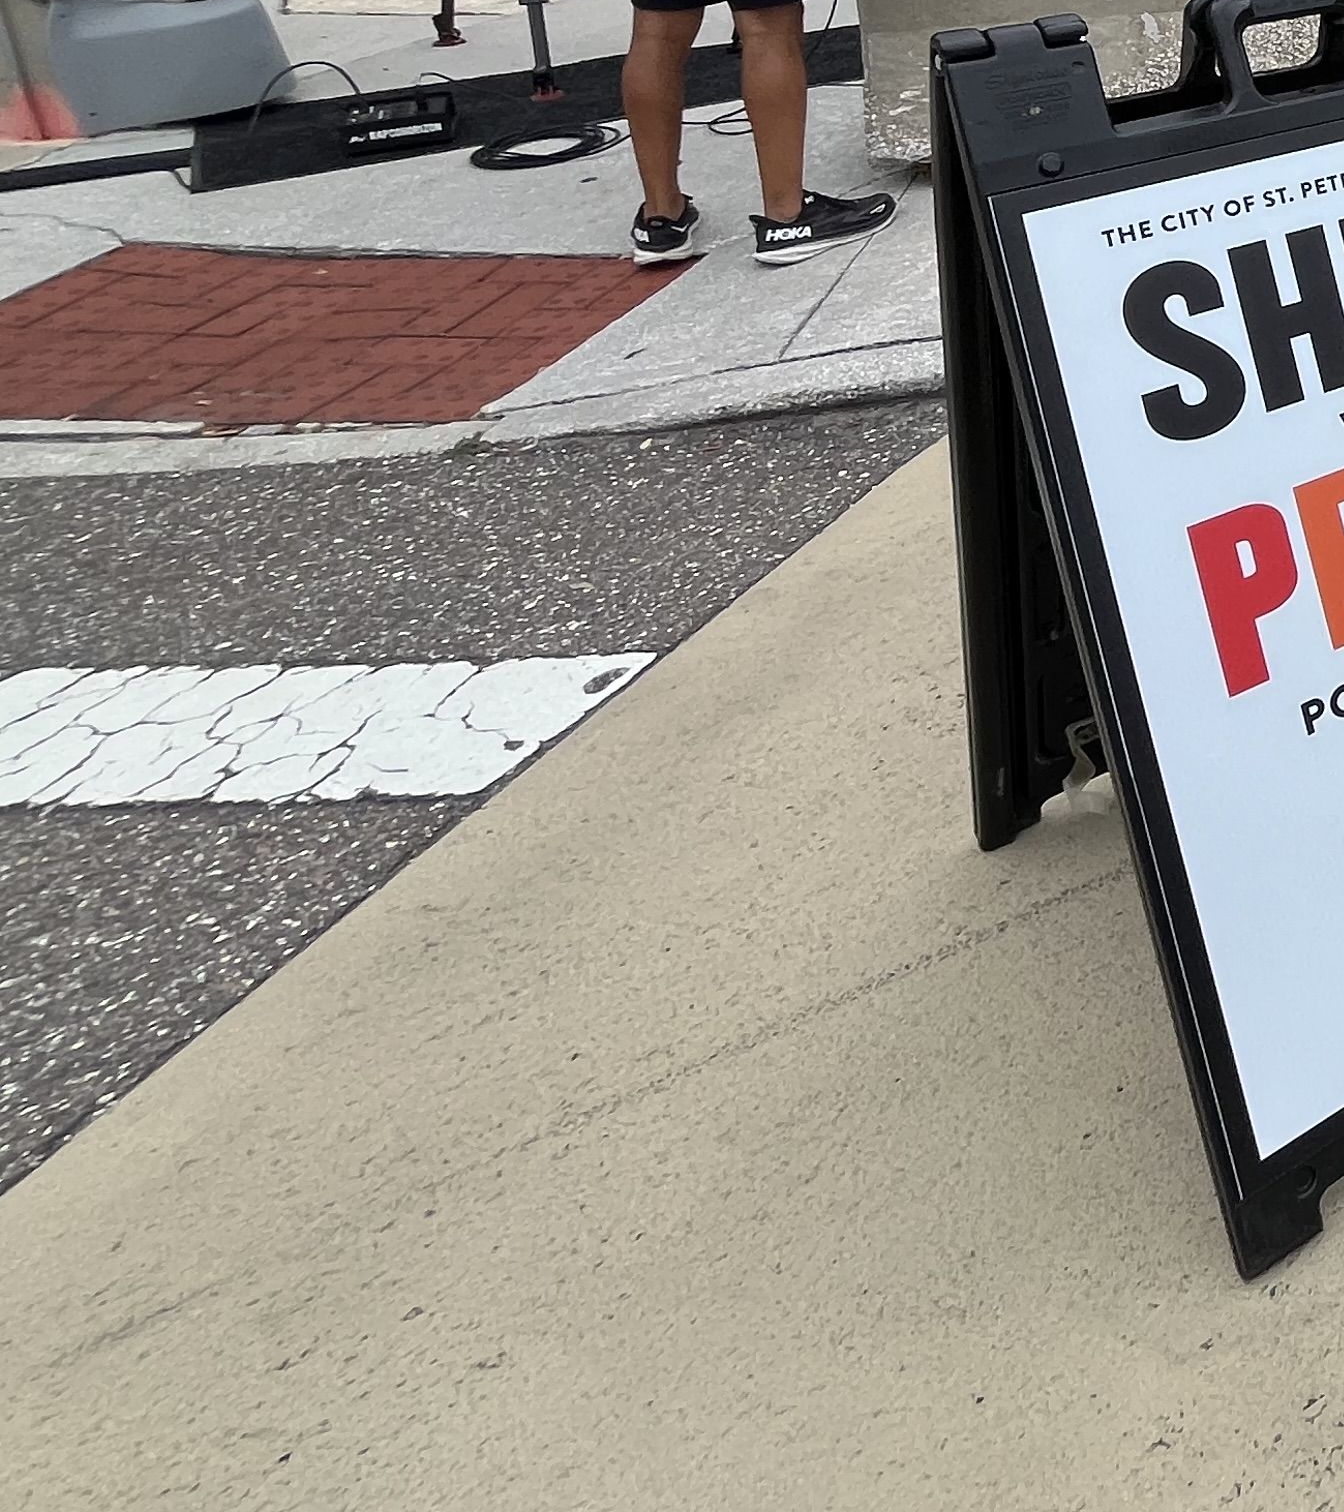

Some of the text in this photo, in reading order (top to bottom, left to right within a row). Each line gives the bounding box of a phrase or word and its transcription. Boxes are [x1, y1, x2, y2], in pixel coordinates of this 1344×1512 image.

[765, 226, 812, 242] HOKA
[1101, 219, 1154, 248] THE
[1161, 204, 1215, 232] CITY
[1224, 195, 1256, 217] OF
[1262, 186, 1295, 208] ST.
